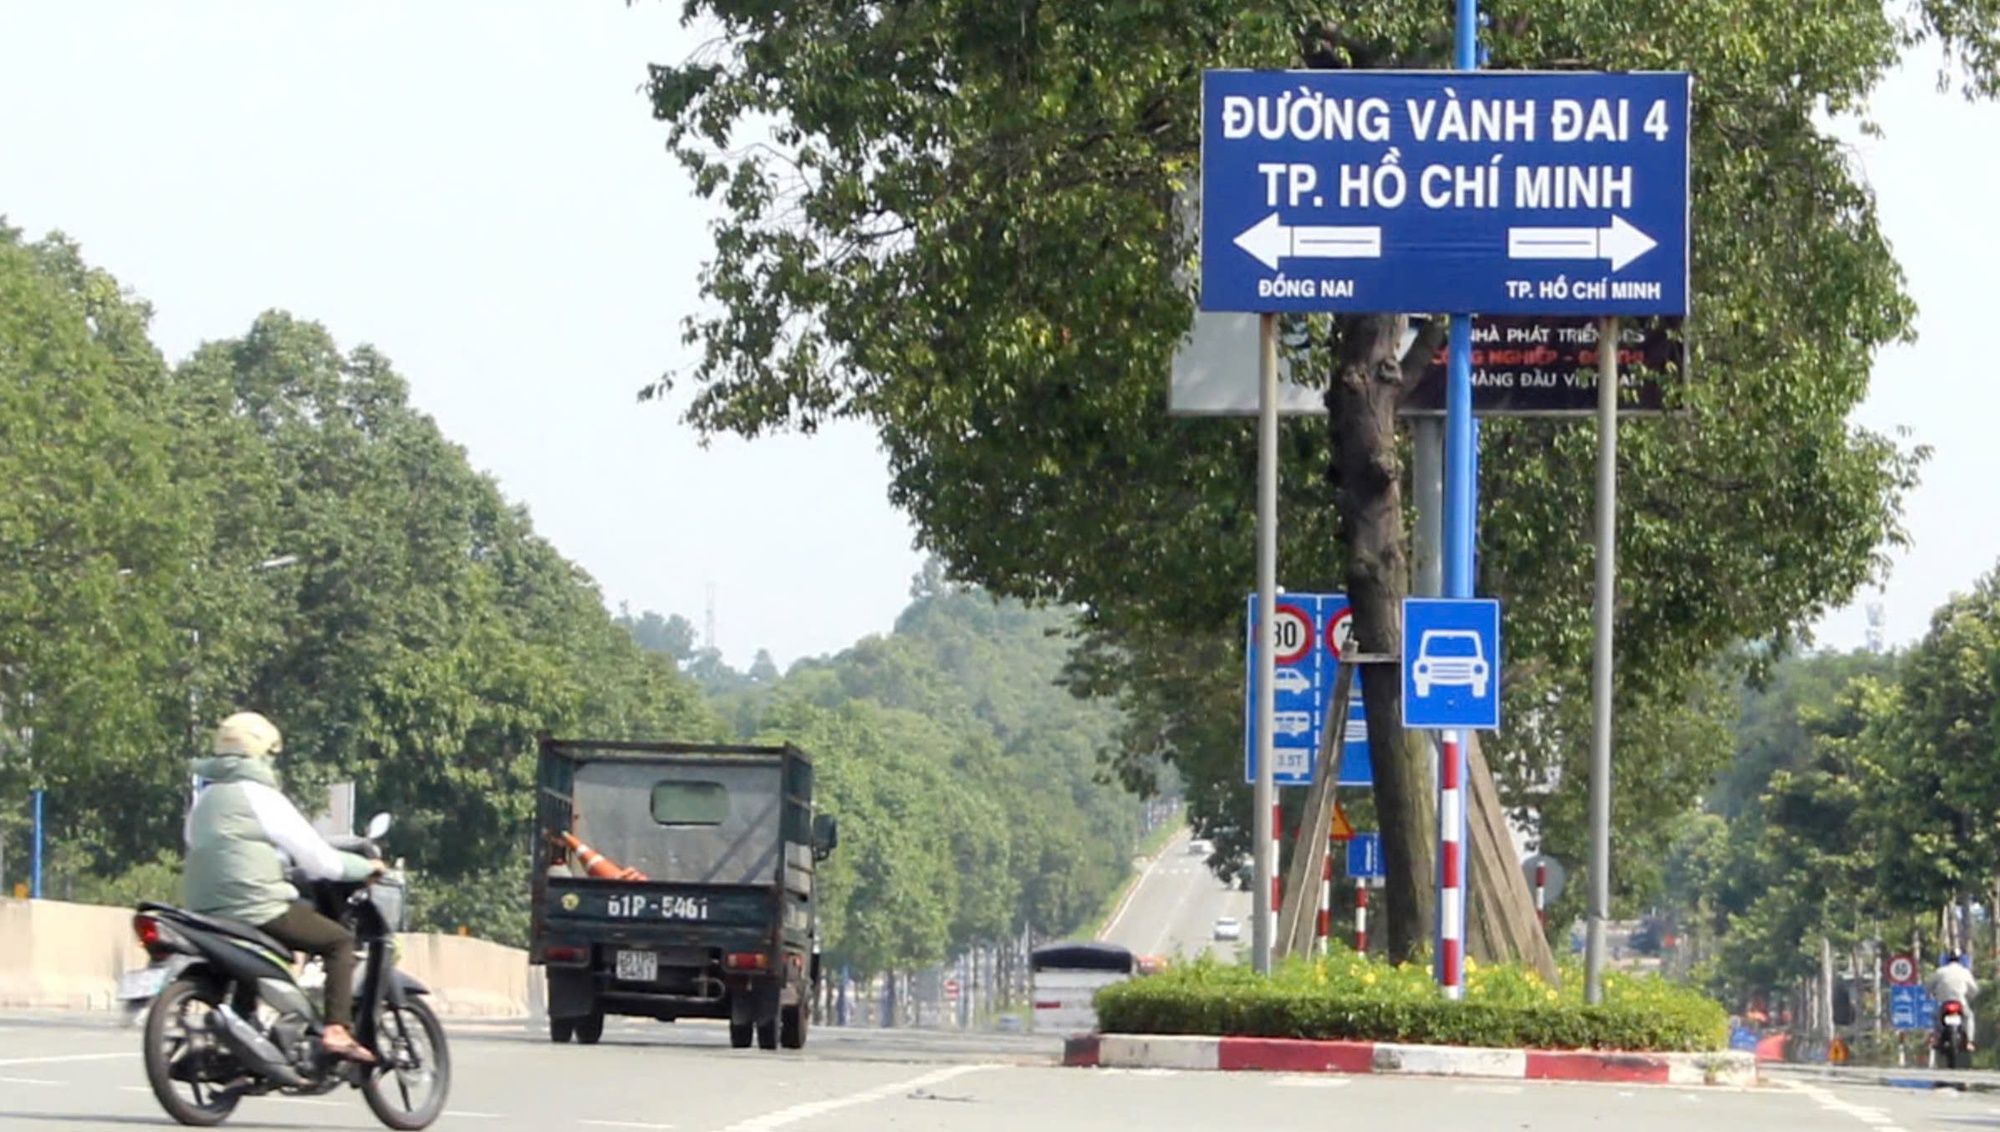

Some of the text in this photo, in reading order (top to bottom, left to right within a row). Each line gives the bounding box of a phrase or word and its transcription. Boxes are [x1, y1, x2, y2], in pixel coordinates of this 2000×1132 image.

[1222, 86, 1669, 142] ĐƯỜNG VÀNH ĐAI 4
[1258, 146, 1632, 209] TP. HỒ CHÍ MINH
[1321, 280, 1353, 297] NAI
[1505, 281, 1534, 299] TP.
[1572, 277, 1607, 300] CHÍ
[1611, 282, 1661, 300] MINH
[1507, 324, 1550, 342] PHÁT
[1521, 367, 1557, 387] ĐẦU
